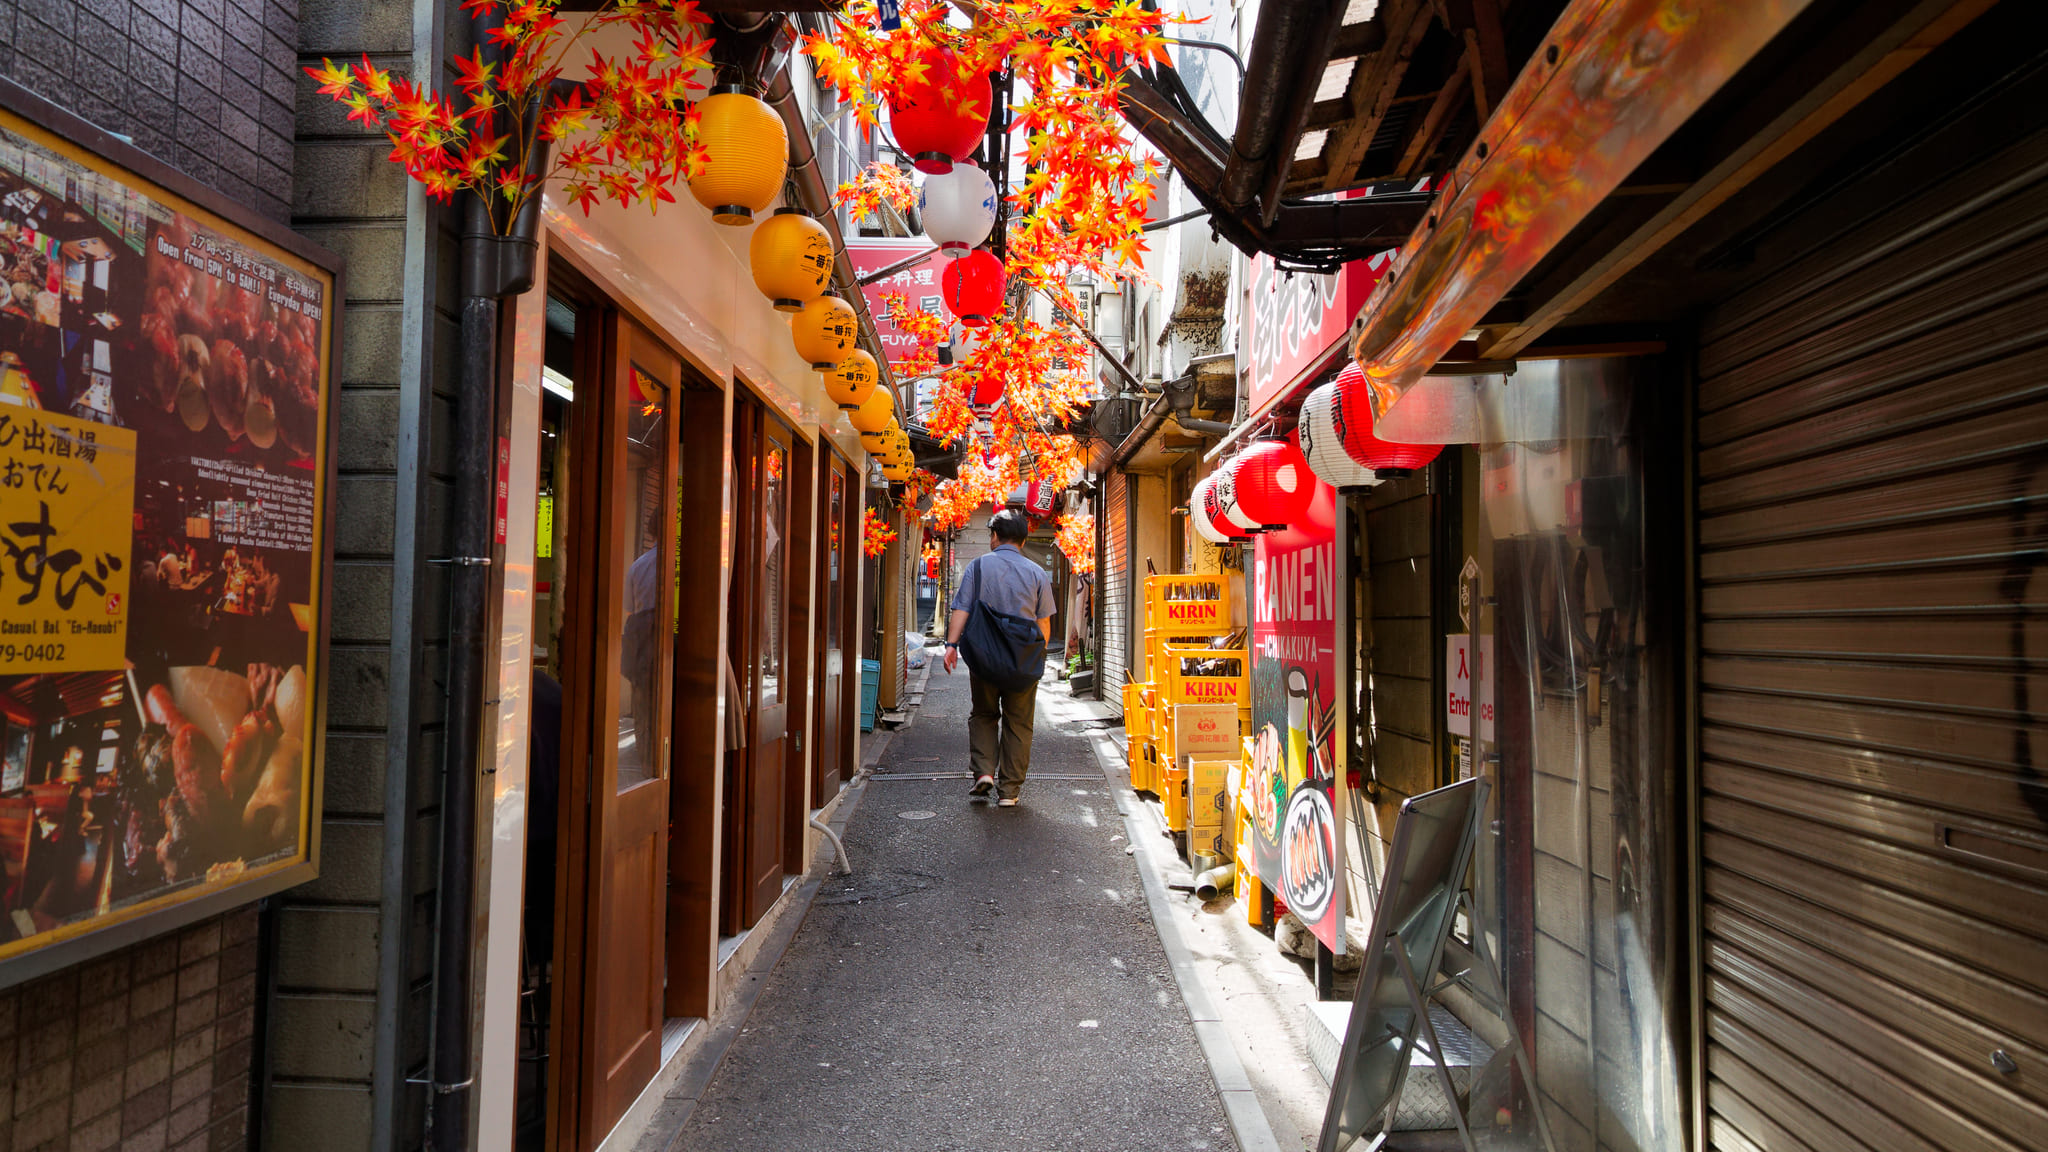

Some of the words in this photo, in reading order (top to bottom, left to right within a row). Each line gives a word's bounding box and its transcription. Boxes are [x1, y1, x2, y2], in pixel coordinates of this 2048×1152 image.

[157, 236, 179, 259] Open
[184, 248, 204, 271] from
[208, 260, 223, 278] 5PM
[226, 268, 236, 284] to
[239, 273, 261, 295] 5AM!!
[268, 286, 300, 313] Everyday
[303, 301, 322, 321] OPEN!
[2, 457, 69, 495] おでん
[0, 500, 122, 611] すび
[1256, 542, 1333, 622] RAMEN
[1168, 604, 1216, 619] KIRIN
[2, 619, 36, 635] Casual
[1264, 634, 1317, 662] ICHIKAKUYA
[1185, 682, 1237, 697] KIRIN
[1449, 692, 1493, 722] Entrce
